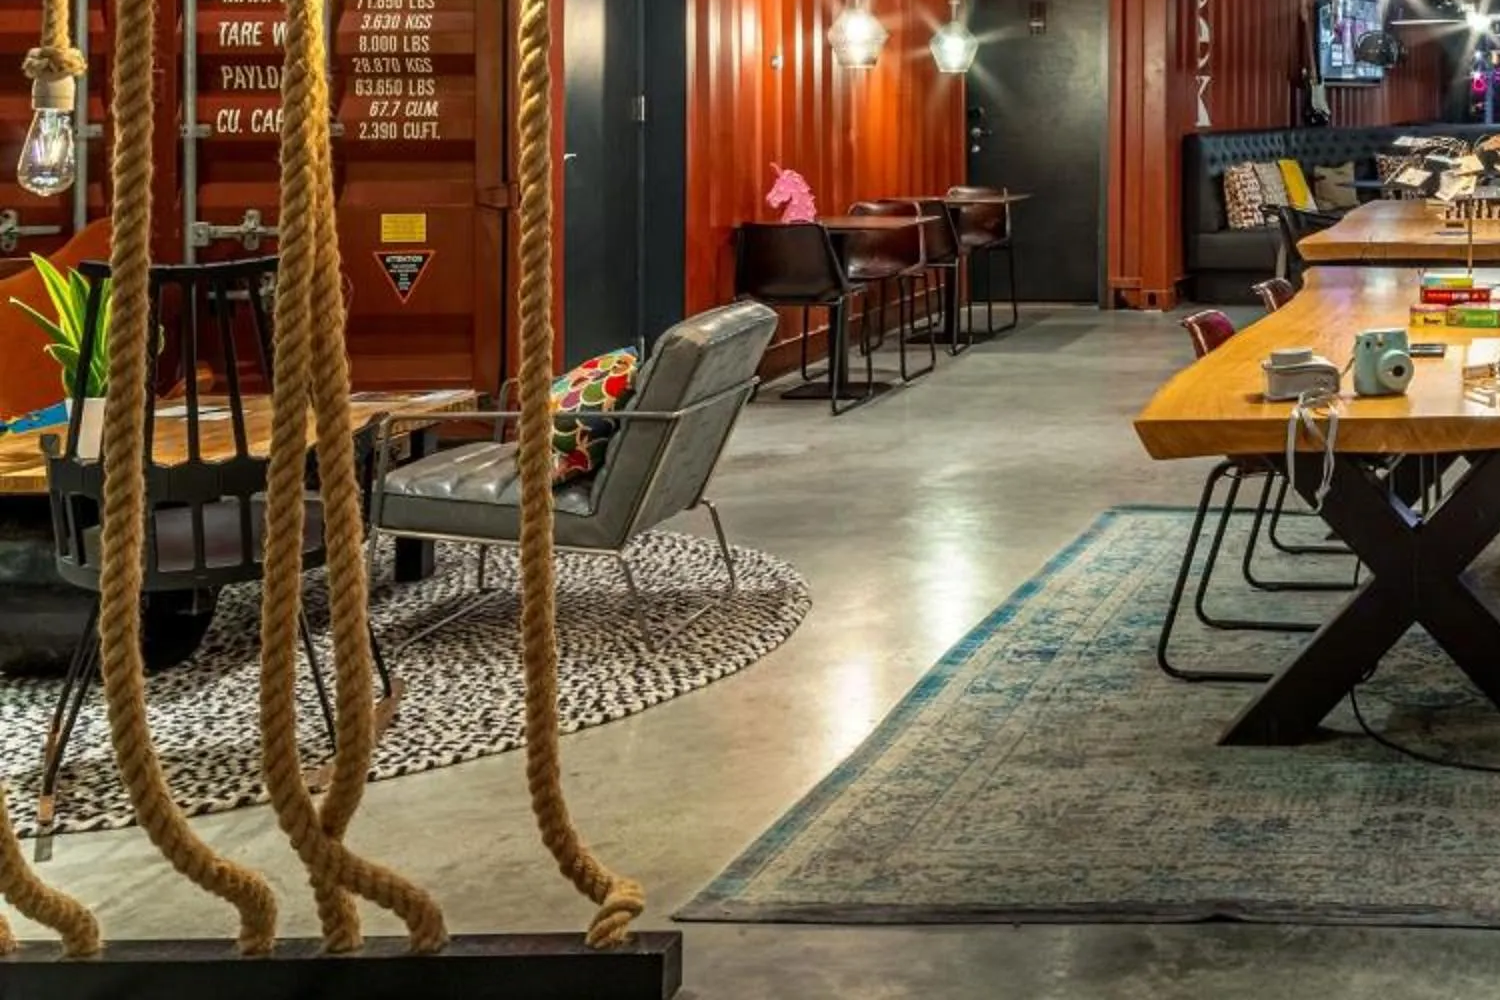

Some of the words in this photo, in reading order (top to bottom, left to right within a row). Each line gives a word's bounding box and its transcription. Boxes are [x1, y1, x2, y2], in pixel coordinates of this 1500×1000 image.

[360, 14, 400, 30] 3.630
[405, 14, 433, 30] KGS
[218, 21, 263, 47] TARE
[359, 35, 397, 52] 8.000
[403, 35, 430, 52] LBS
[405, 57, 433, 73] KGS
[220, 64, 284, 90] PAYLO
[355, 79, 403, 96] 63.650
[408, 79, 436, 96] LBS
[369, 101, 400, 117] 67.7
[217, 108, 243, 134] CU.
[359, 122, 398, 140] 2.390
